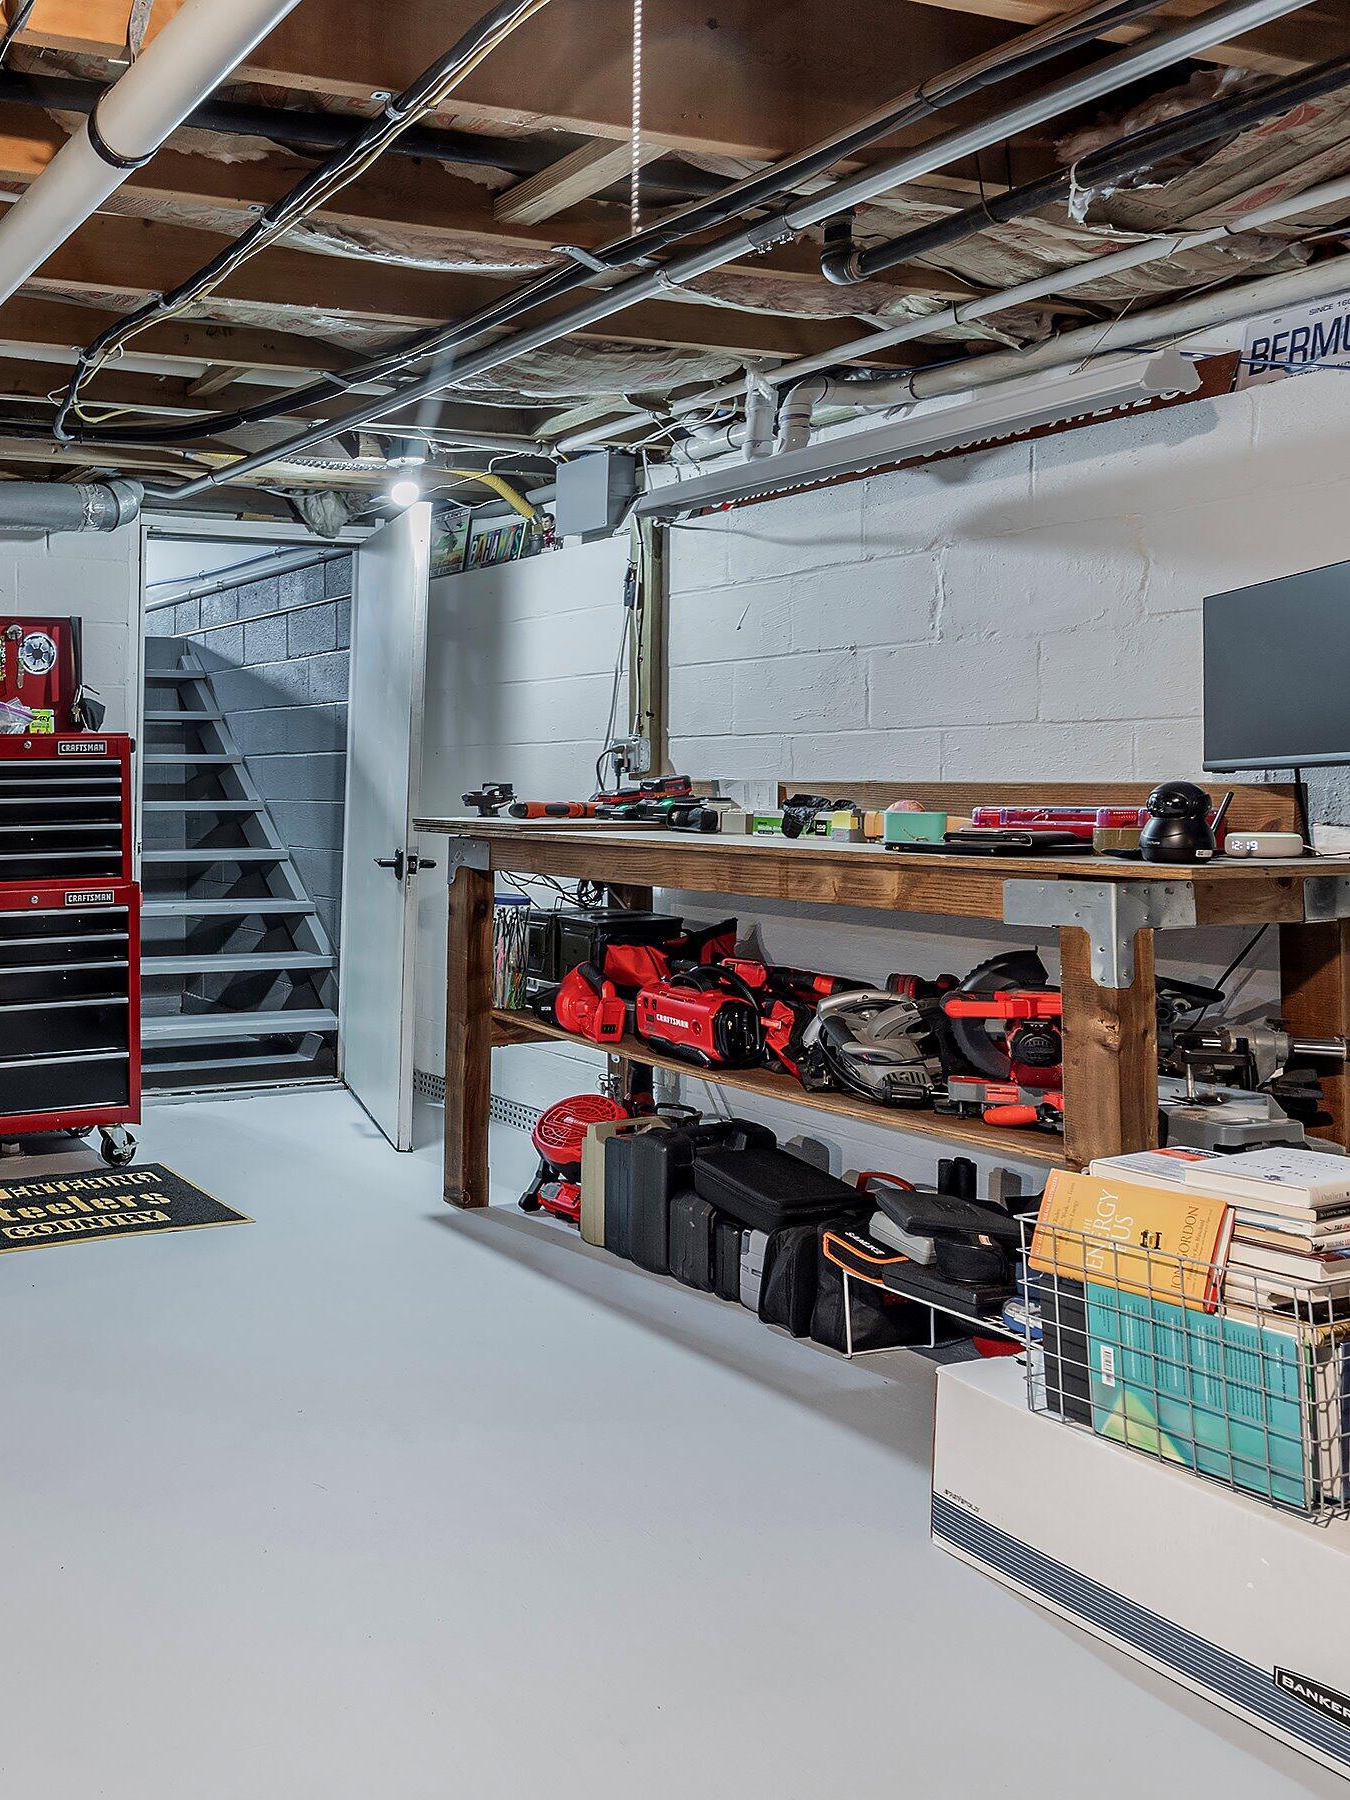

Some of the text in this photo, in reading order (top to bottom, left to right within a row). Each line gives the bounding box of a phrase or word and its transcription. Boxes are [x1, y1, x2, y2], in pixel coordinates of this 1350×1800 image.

[1309, 298, 1350, 316] SINCE 16
[60, 742, 104, 752] CRAFTSMAN
[1231, 840, 1259, 850] 12:19
[68, 892, 112, 903] CRAFTSMAN
[656, 1013, 689, 1029] CRAFTSMAN
[7, 1172, 162, 1199] ENTERING
[6, 1211, 165, 1238] COUNTRY
